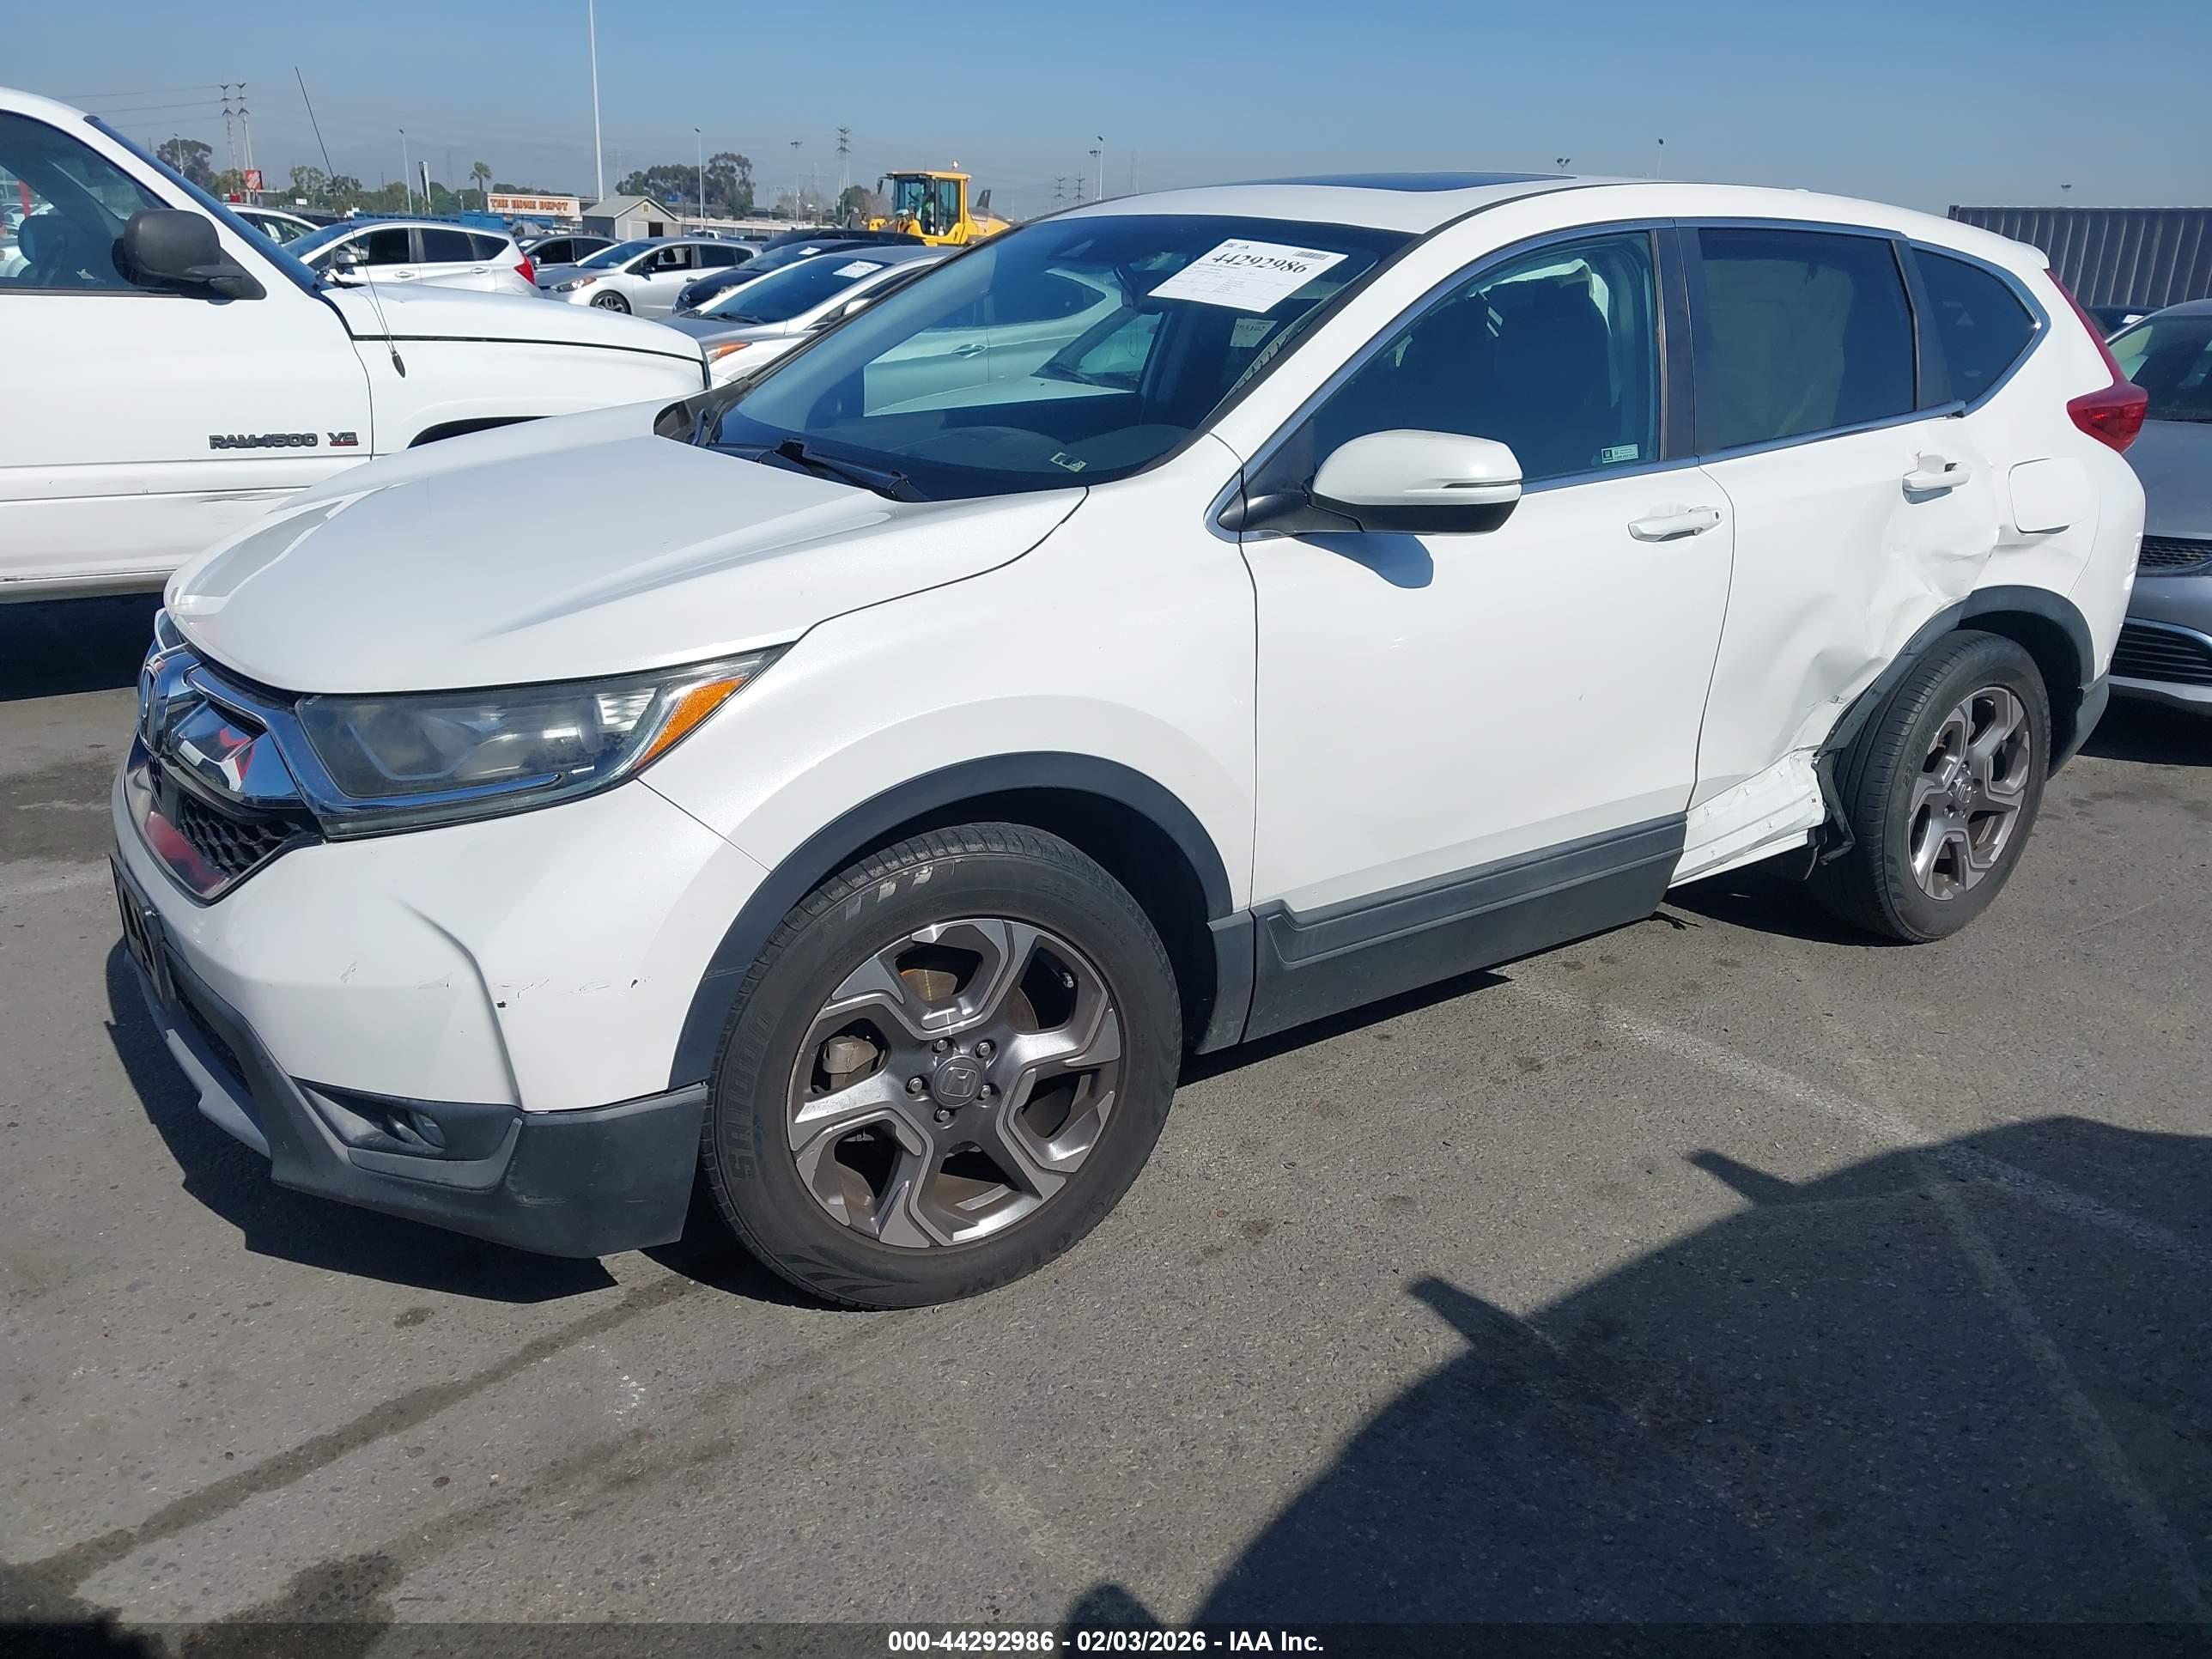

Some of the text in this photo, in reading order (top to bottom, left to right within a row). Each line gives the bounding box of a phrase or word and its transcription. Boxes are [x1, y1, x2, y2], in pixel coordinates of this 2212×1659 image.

[490, 198, 568, 211] THE HOME DEPOT
[1212, 252, 1312, 274] 44292986
